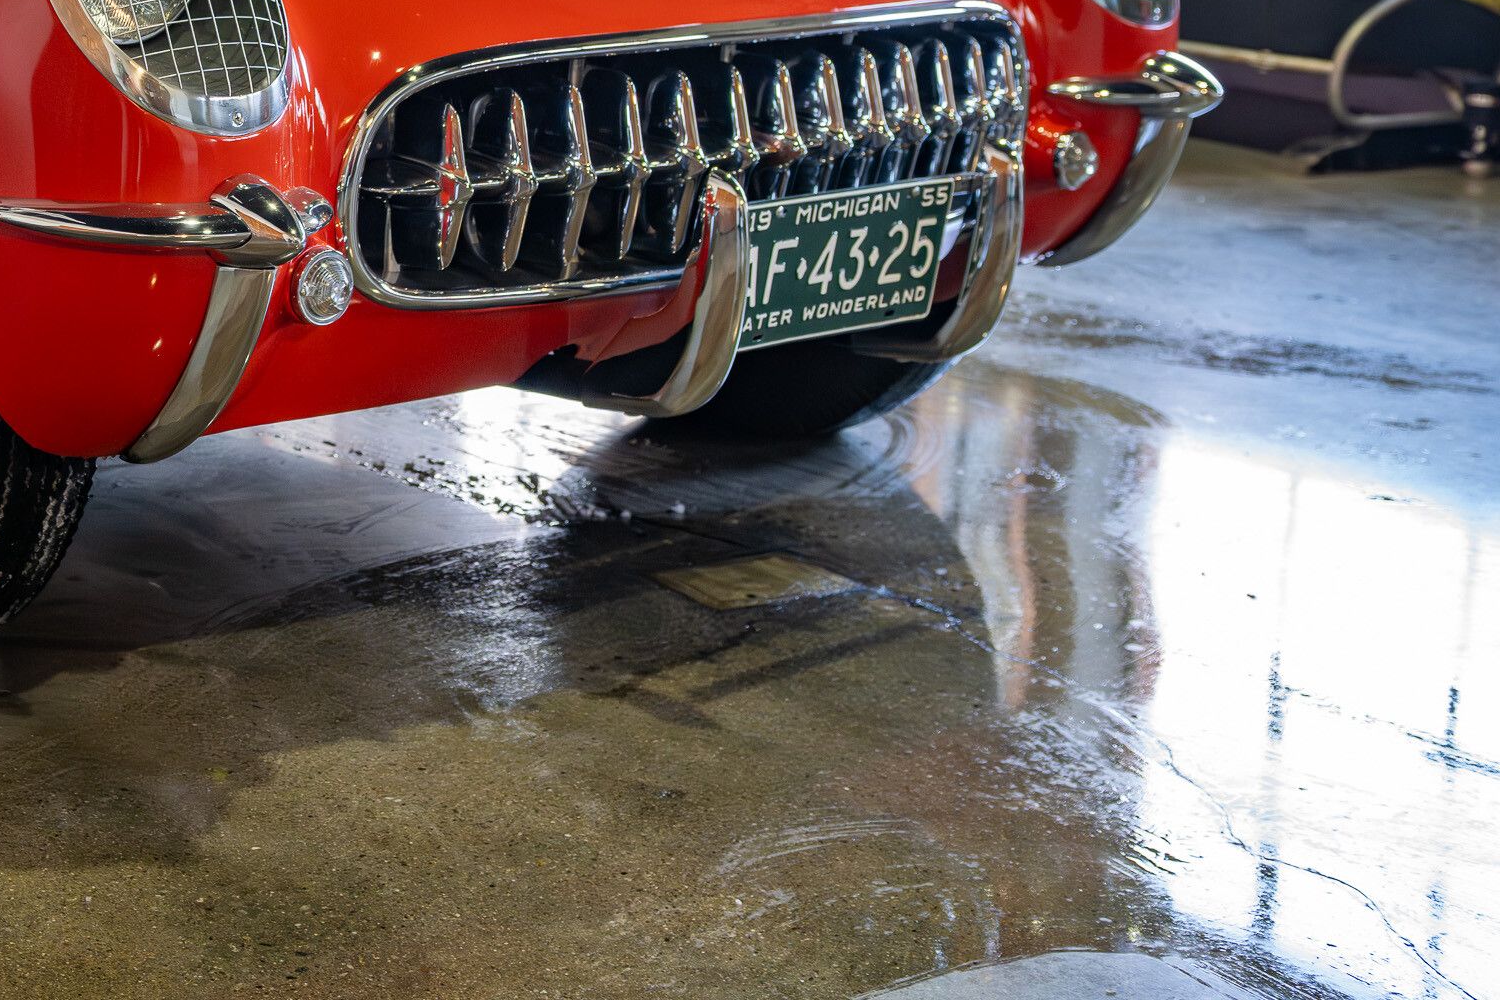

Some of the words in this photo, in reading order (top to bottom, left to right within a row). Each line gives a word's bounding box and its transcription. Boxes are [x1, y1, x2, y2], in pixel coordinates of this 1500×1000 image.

[749, 209, 772, 233] 19
[795, 192, 901, 226] MICHIGAN
[920, 185, 950, 207] 55
[742, 308, 793, 333] ATER
[801, 285, 927, 322] WONDERLAND
